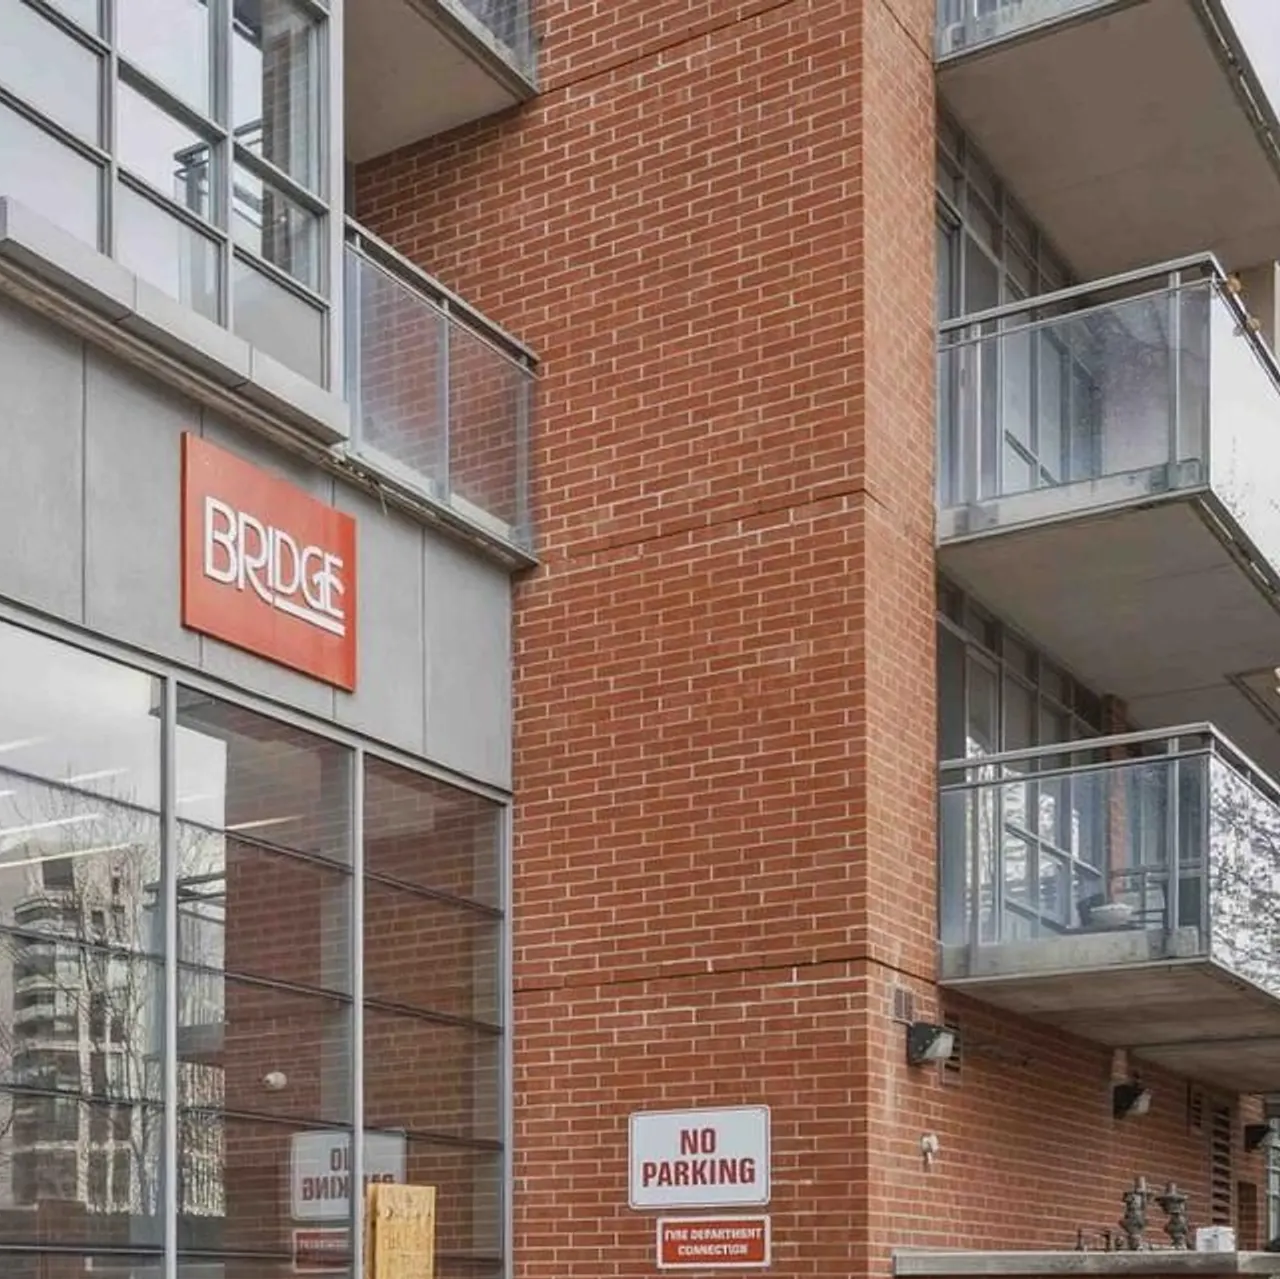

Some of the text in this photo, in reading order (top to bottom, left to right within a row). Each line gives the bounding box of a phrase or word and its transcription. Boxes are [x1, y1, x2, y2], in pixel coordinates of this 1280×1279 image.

[204, 495, 345, 636] BRIDGE
[679, 1127, 717, 1156] NO
[642, 1157, 756, 1188] PARKING
